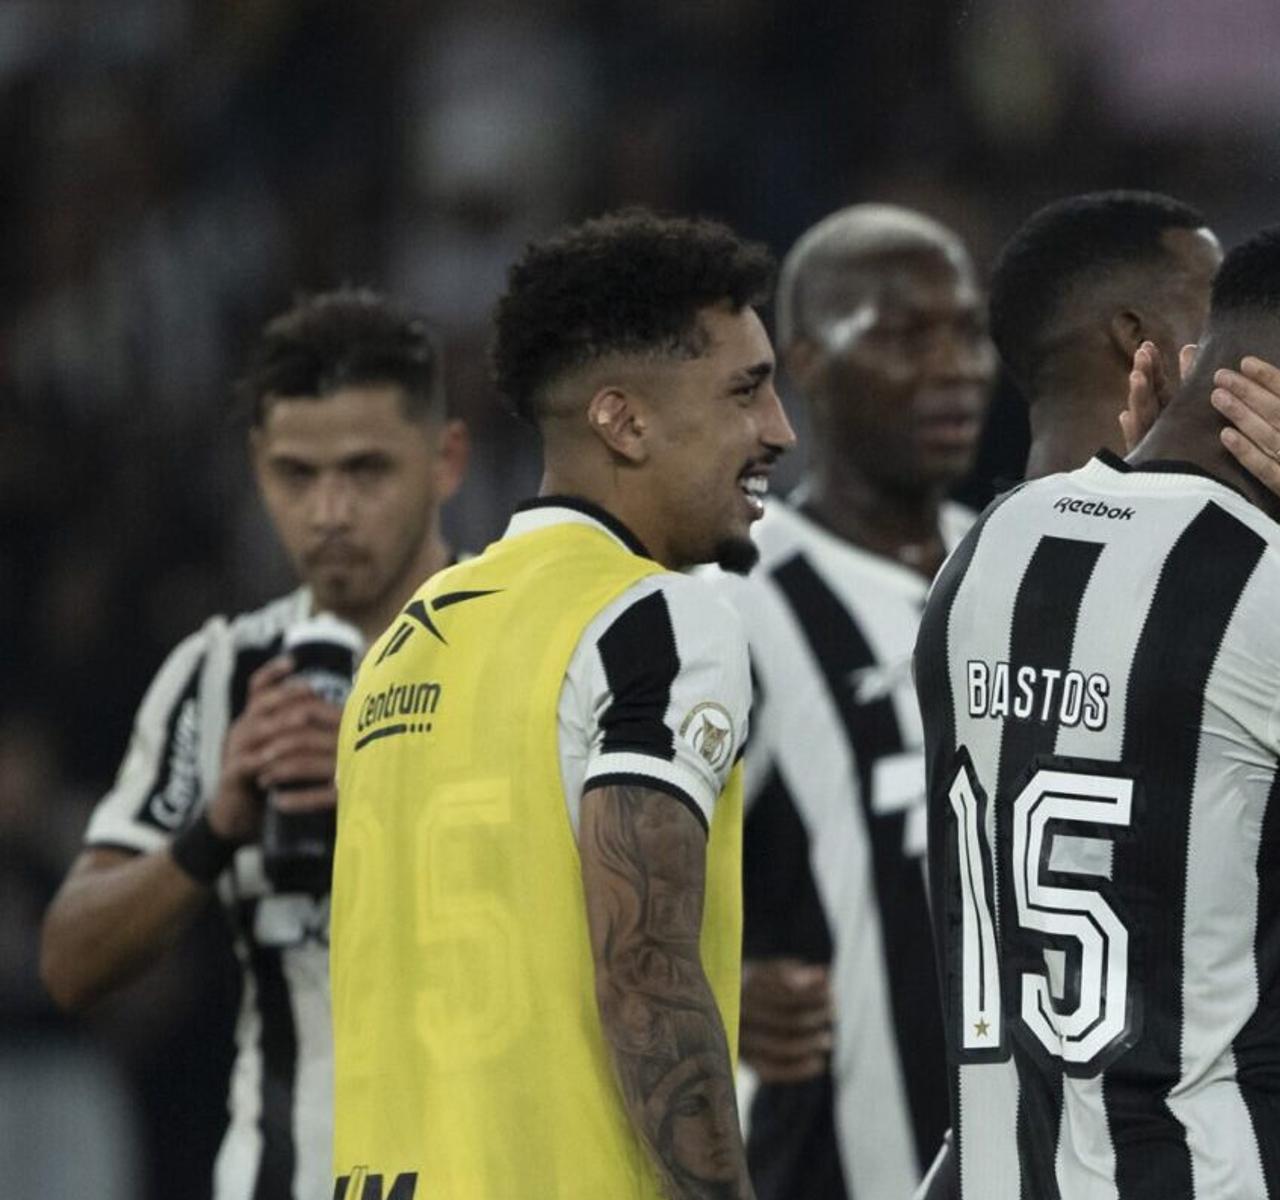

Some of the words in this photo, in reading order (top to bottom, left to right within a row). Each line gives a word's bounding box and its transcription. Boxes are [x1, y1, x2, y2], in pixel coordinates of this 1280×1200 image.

[1053, 497, 1136, 521] Reebok
[357, 683, 442, 733] Centrum
[966, 659, 1110, 730] BASTOS
[948, 765, 1134, 1065] 15
